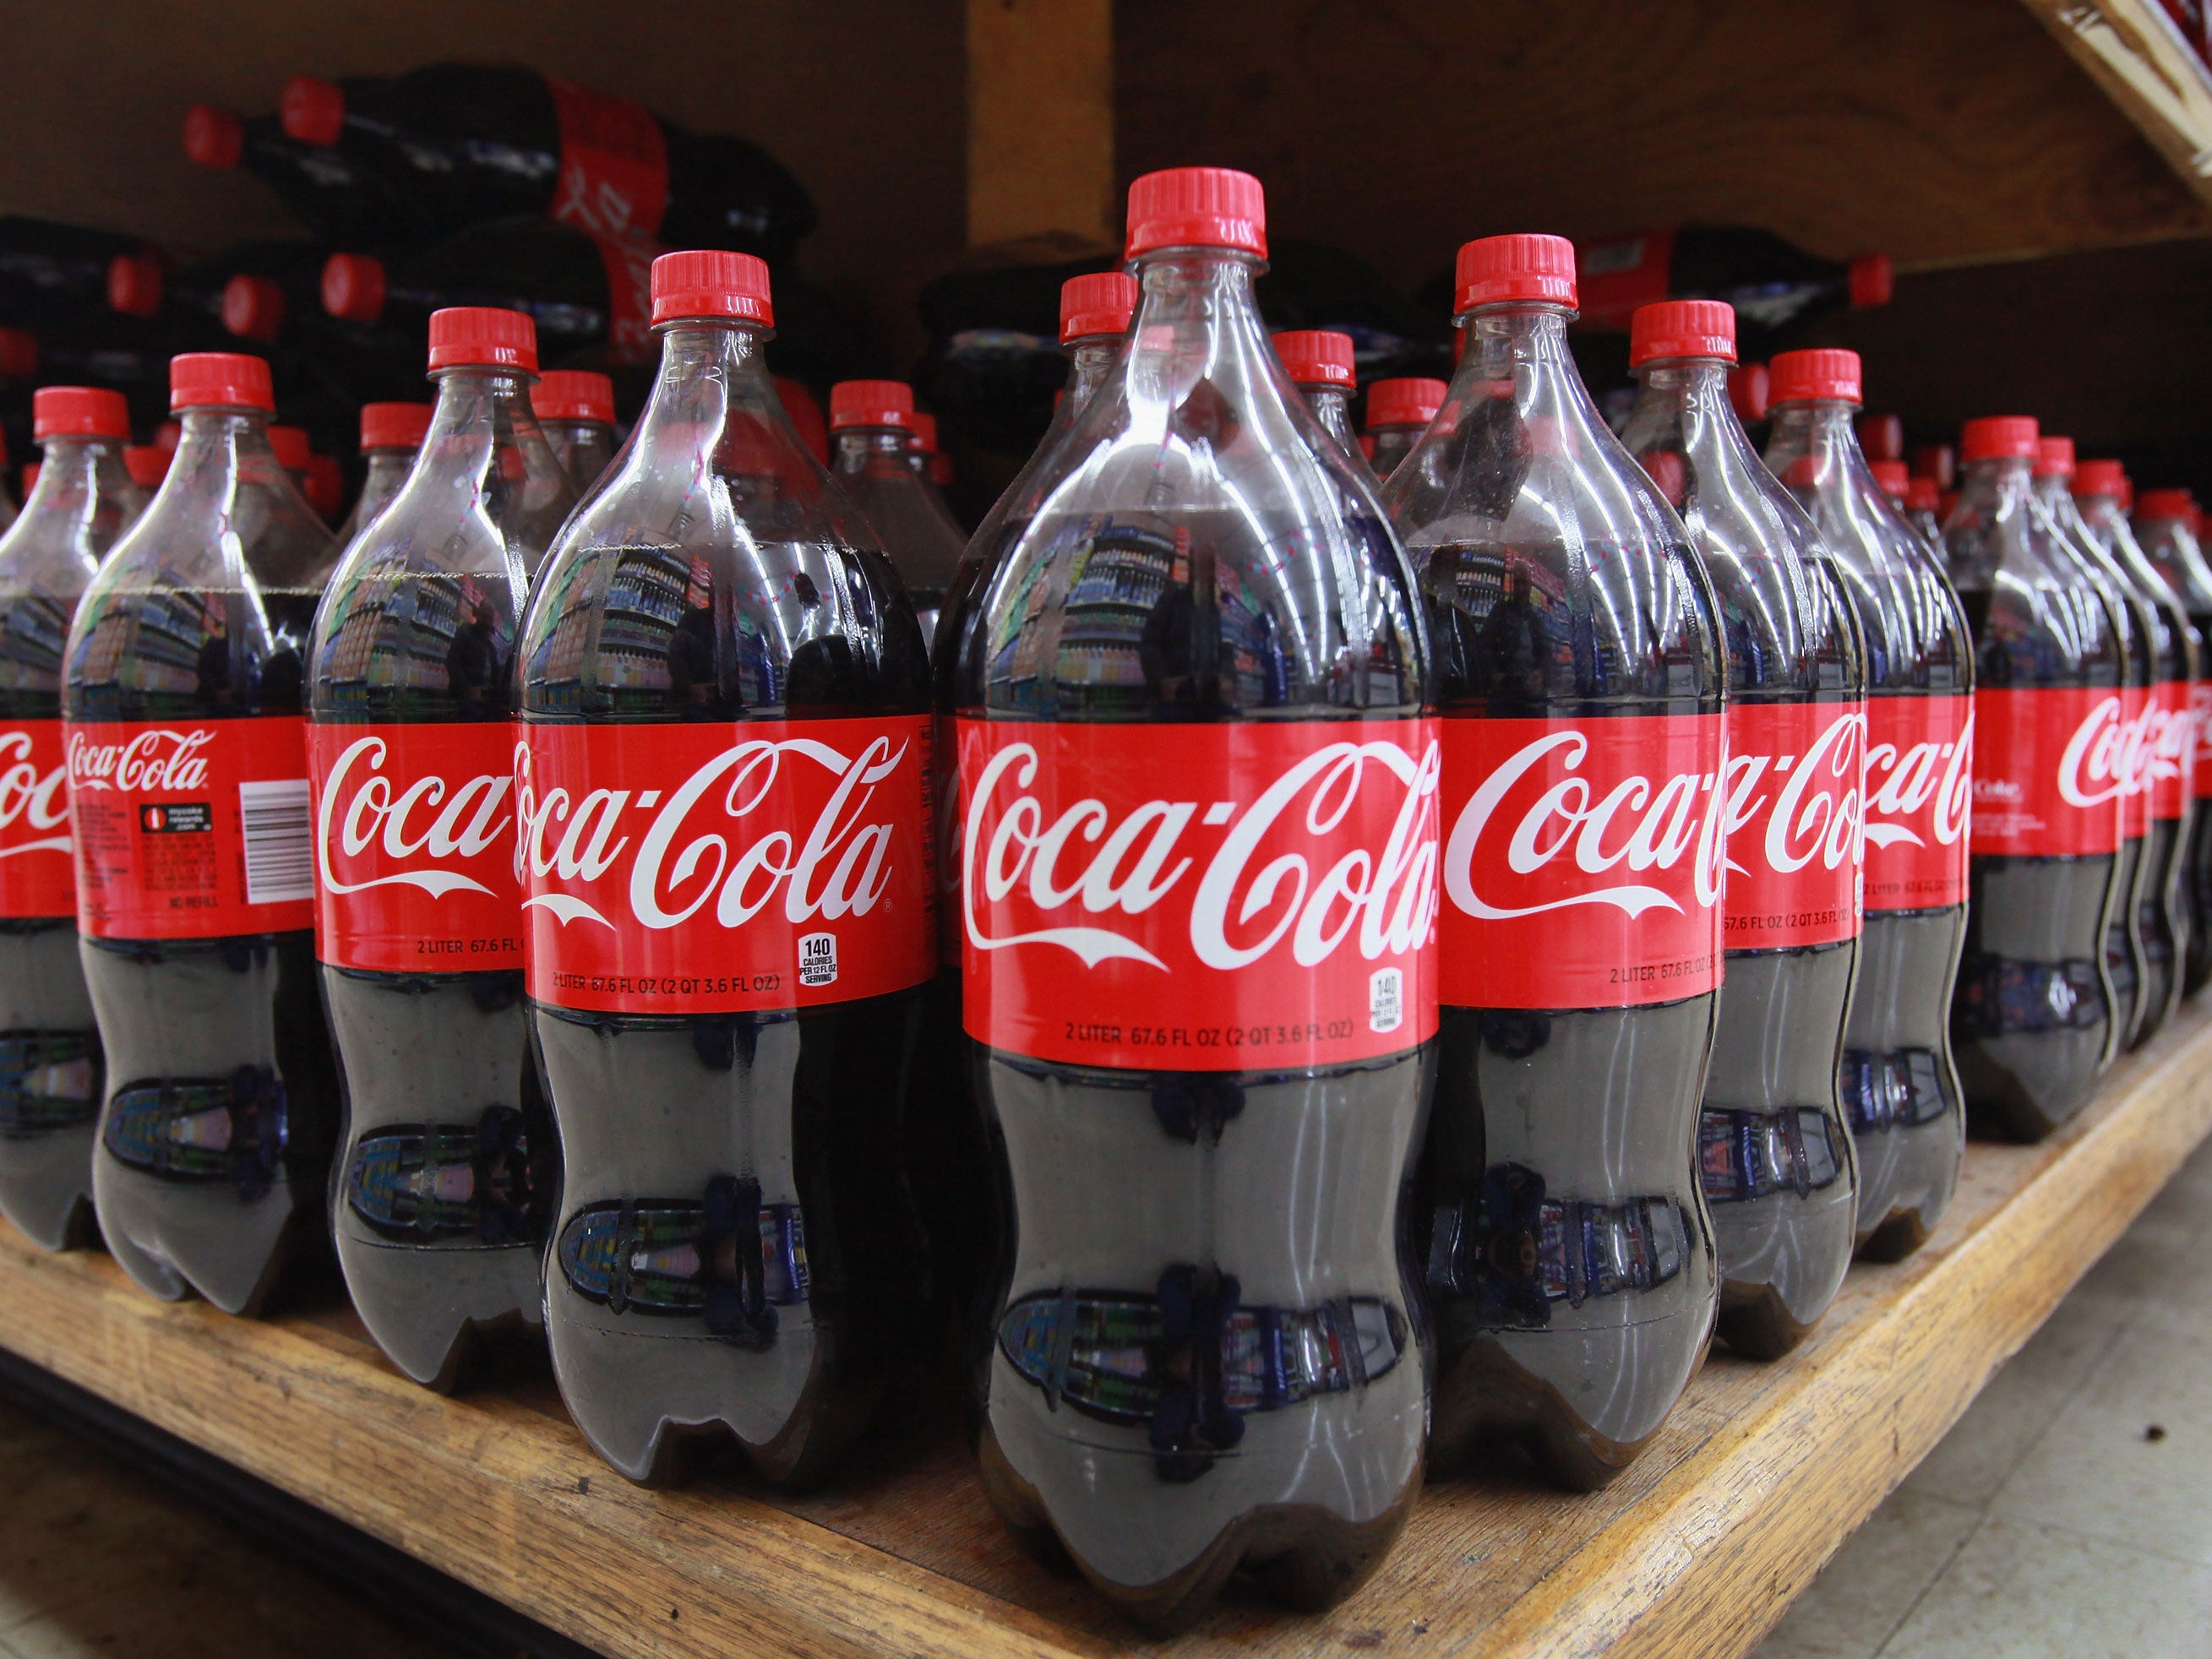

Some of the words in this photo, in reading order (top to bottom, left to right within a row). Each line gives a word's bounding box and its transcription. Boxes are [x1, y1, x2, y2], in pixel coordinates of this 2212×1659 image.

[68, 729, 216, 791] Coca-Cola
[964, 741, 1441, 972] Coca-Cola
[1751, 917, 1763, 929] FL
[1768, 916, 1783, 928] OZ
[1799, 912, 1812, 927] QT
[1815, 911, 1828, 925] 3.6
[417, 940, 425, 954] 2
[428, 939, 463, 954] LITER
[471, 938, 499, 953] 67.6
[502, 937, 516, 951] FL
[805, 938, 831, 957] 140
[799, 966, 813, 976] PER
[813, 965, 820, 974] 12
[820, 965, 828, 973] FL
[828, 964, 836, 972] OZ
[803, 956, 833, 966] CALORIES
[805, 973, 832, 984] SERVING
[1610, 969, 1618, 982] 2
[1621, 965, 1655, 982] LITER
[1661, 962, 1681, 979] 67.6
[1684, 960, 1693, 975] FL
[553, 972, 558, 986] 2
[559, 974, 586, 990] LITER
[591, 976, 617, 993] 67.6
[619, 977, 634, 993] FL
[638, 979, 657, 994] OZ
[661, 978, 676, 995] (2
[680, 978, 700, 994] QT
[705, 977, 727, 993] 3.6
[732, 977, 749, 993] FL
[753, 974, 780, 991] OZ)
[1065, 1022, 1074, 1041] 2
[1079, 1024, 1122, 1043] LITER
[1131, 1027, 1168, 1047] 67.6
[1172, 1028, 1191, 1047] FL
[1196, 1029, 1220, 1047] OZ
[1227, 1027, 1244, 1047] (2
[1250, 1027, 1272, 1046] QT
[1277, 1025, 1301, 1044] 3.6
[1306, 1024, 1323, 1042] FL
